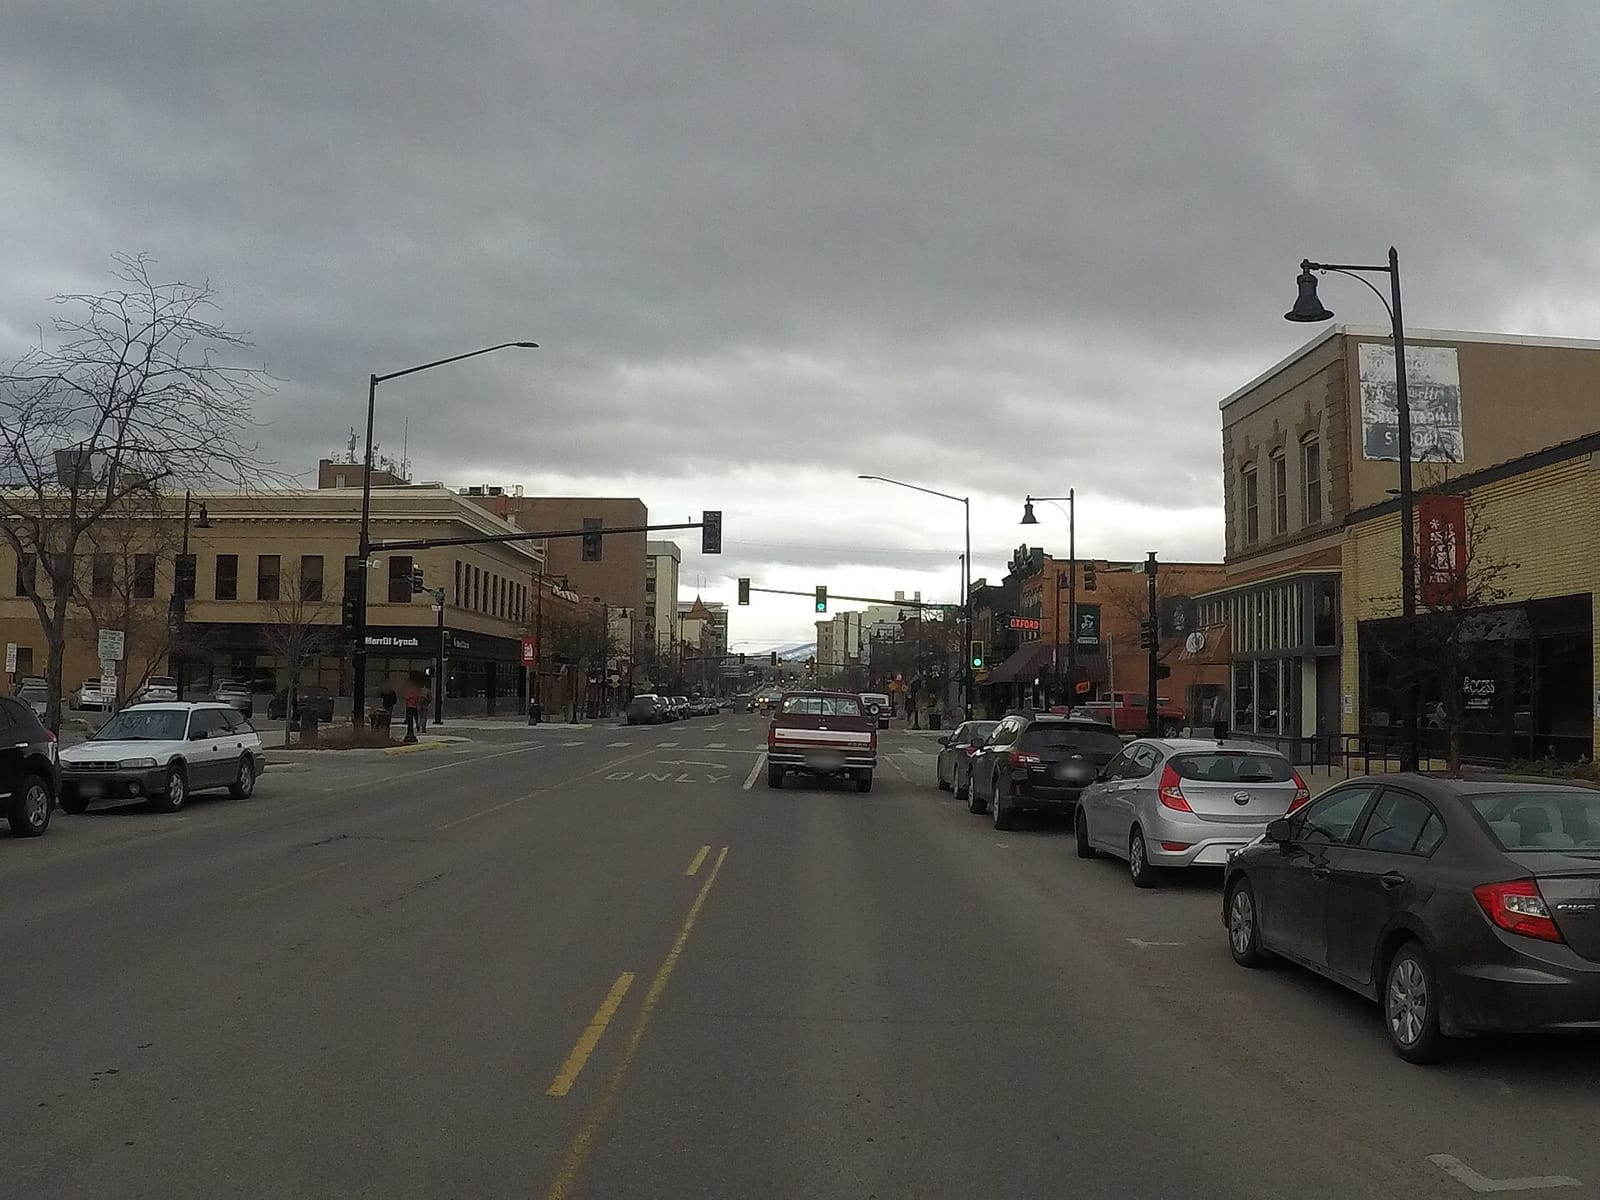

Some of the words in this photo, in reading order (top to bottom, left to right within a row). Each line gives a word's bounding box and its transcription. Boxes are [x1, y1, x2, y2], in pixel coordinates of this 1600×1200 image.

[1010, 619, 1039, 630] OXFORD
[364, 637, 392, 646] Merrill
[393, 637, 418, 648] Lynch
[604, 771, 732, 784] ONLY
